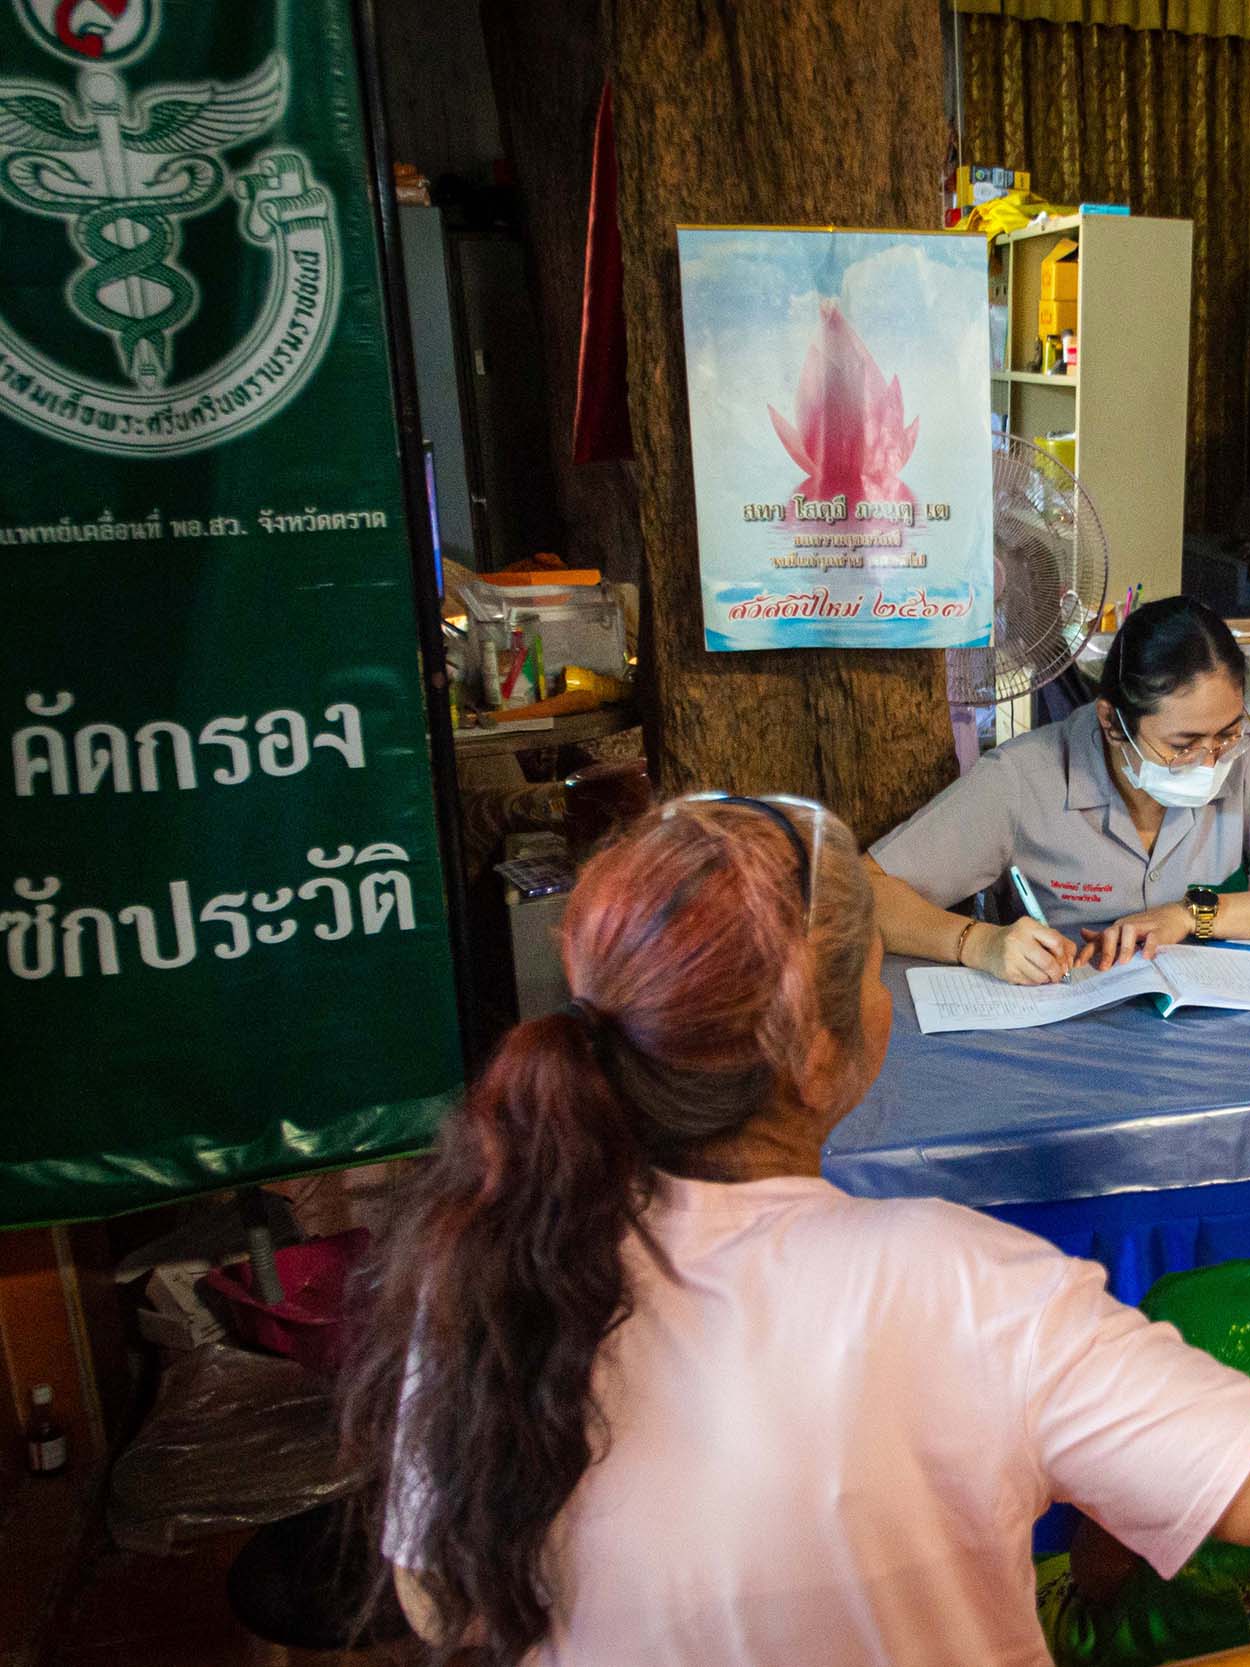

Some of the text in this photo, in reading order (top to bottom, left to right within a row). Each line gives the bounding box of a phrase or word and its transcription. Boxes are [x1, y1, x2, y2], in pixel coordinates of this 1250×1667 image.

[169, 514, 249, 538] พอ.สว.
[258, 507, 388, 535] จังหวัดตราด
[728, 586, 975, 621] สวัสดีปีใหม่ ๒๕๖๗
[12, 691, 366, 797] คัดกรอง
[0, 842, 417, 980] ซักประวัติ
